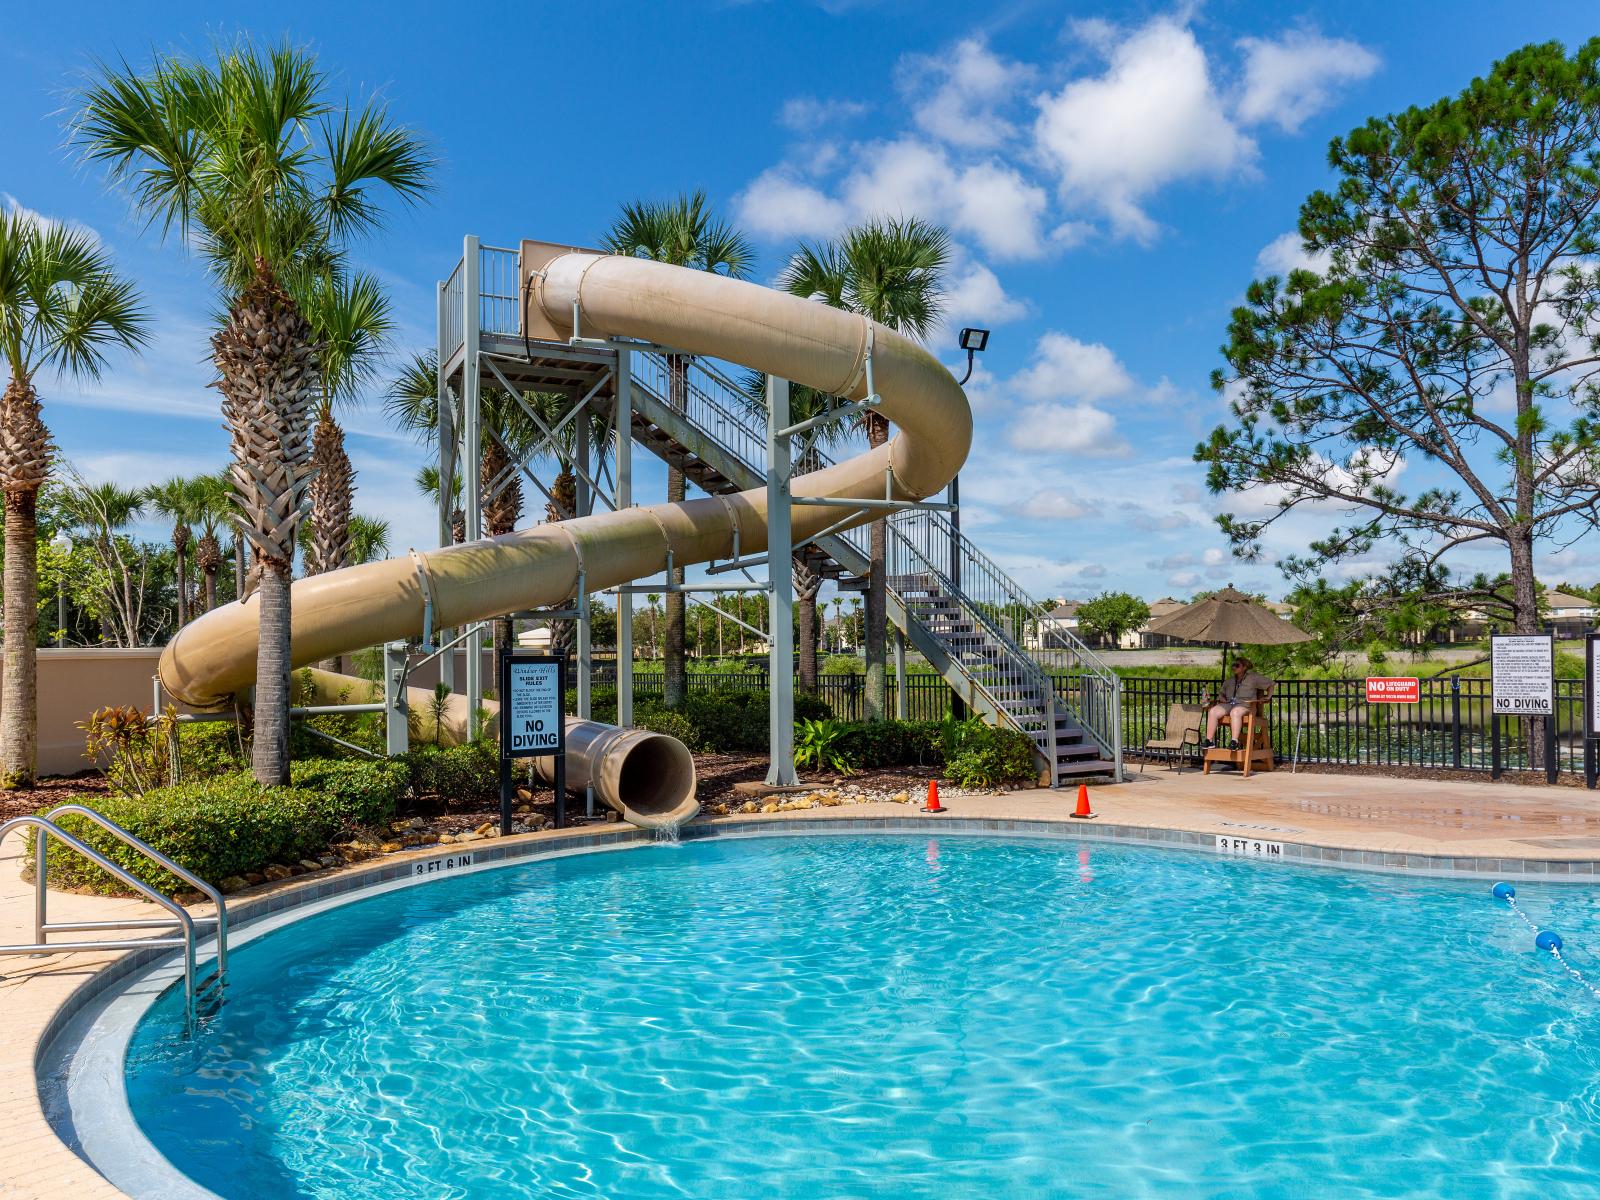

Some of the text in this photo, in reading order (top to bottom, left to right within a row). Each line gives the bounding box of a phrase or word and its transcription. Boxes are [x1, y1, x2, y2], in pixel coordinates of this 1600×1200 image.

[539, 665, 556, 674] Hills
[1369, 681, 1385, 692] NO
[1496, 698, 1549, 709] NO DIVING
[525, 719, 544, 732] NO
[513, 733, 557, 747] DIVING
[1220, 838, 1280, 855] 3 FT 3 IN
[416, 855, 471, 874] 3 FT 6 IN
